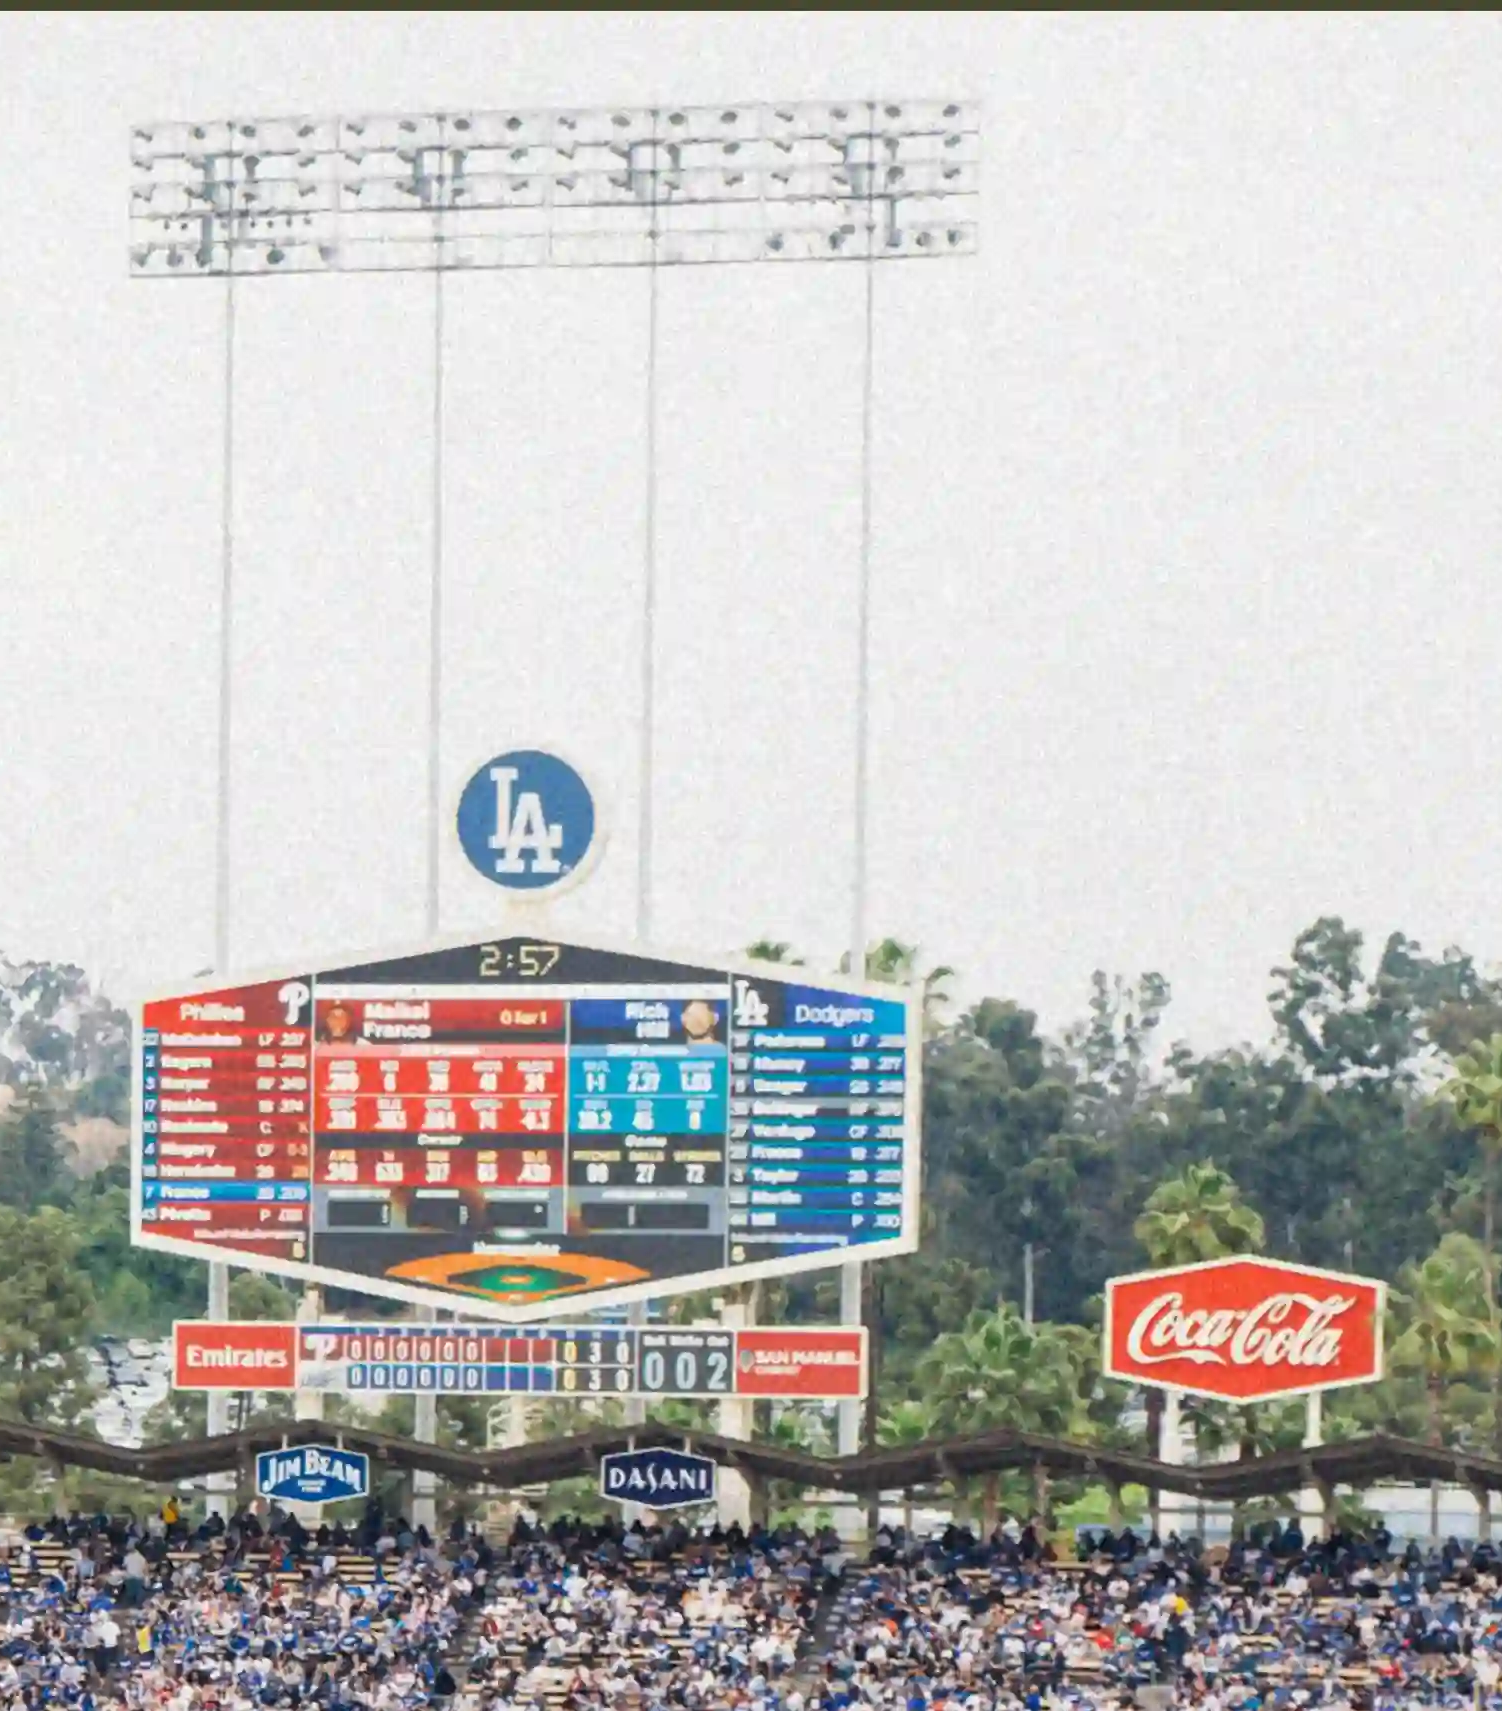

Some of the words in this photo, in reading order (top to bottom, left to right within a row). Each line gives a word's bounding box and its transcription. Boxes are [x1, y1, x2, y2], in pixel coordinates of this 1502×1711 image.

[488, 767, 563, 873] LA
[479, 944, 561, 976] 2:57
[278, 983, 310, 1025] P
[733, 980, 769, 1026] LA
[795, 1004, 874, 1027] Dodgers
[364, 1021, 431, 1038] Franco
[1126, 1291, 1356, 1367] Coca-Cola
[186, 1343, 288, 1368] Emirates
[644, 1351, 664, 1390] 0
[675, 1351, 697, 1390] 0
[706, 1351, 728, 1390] 2
[262, 1455, 301, 1493] JIM
[304, 1449, 363, 1493] BEAM
[608, 1462, 707, 1494] DASANI
